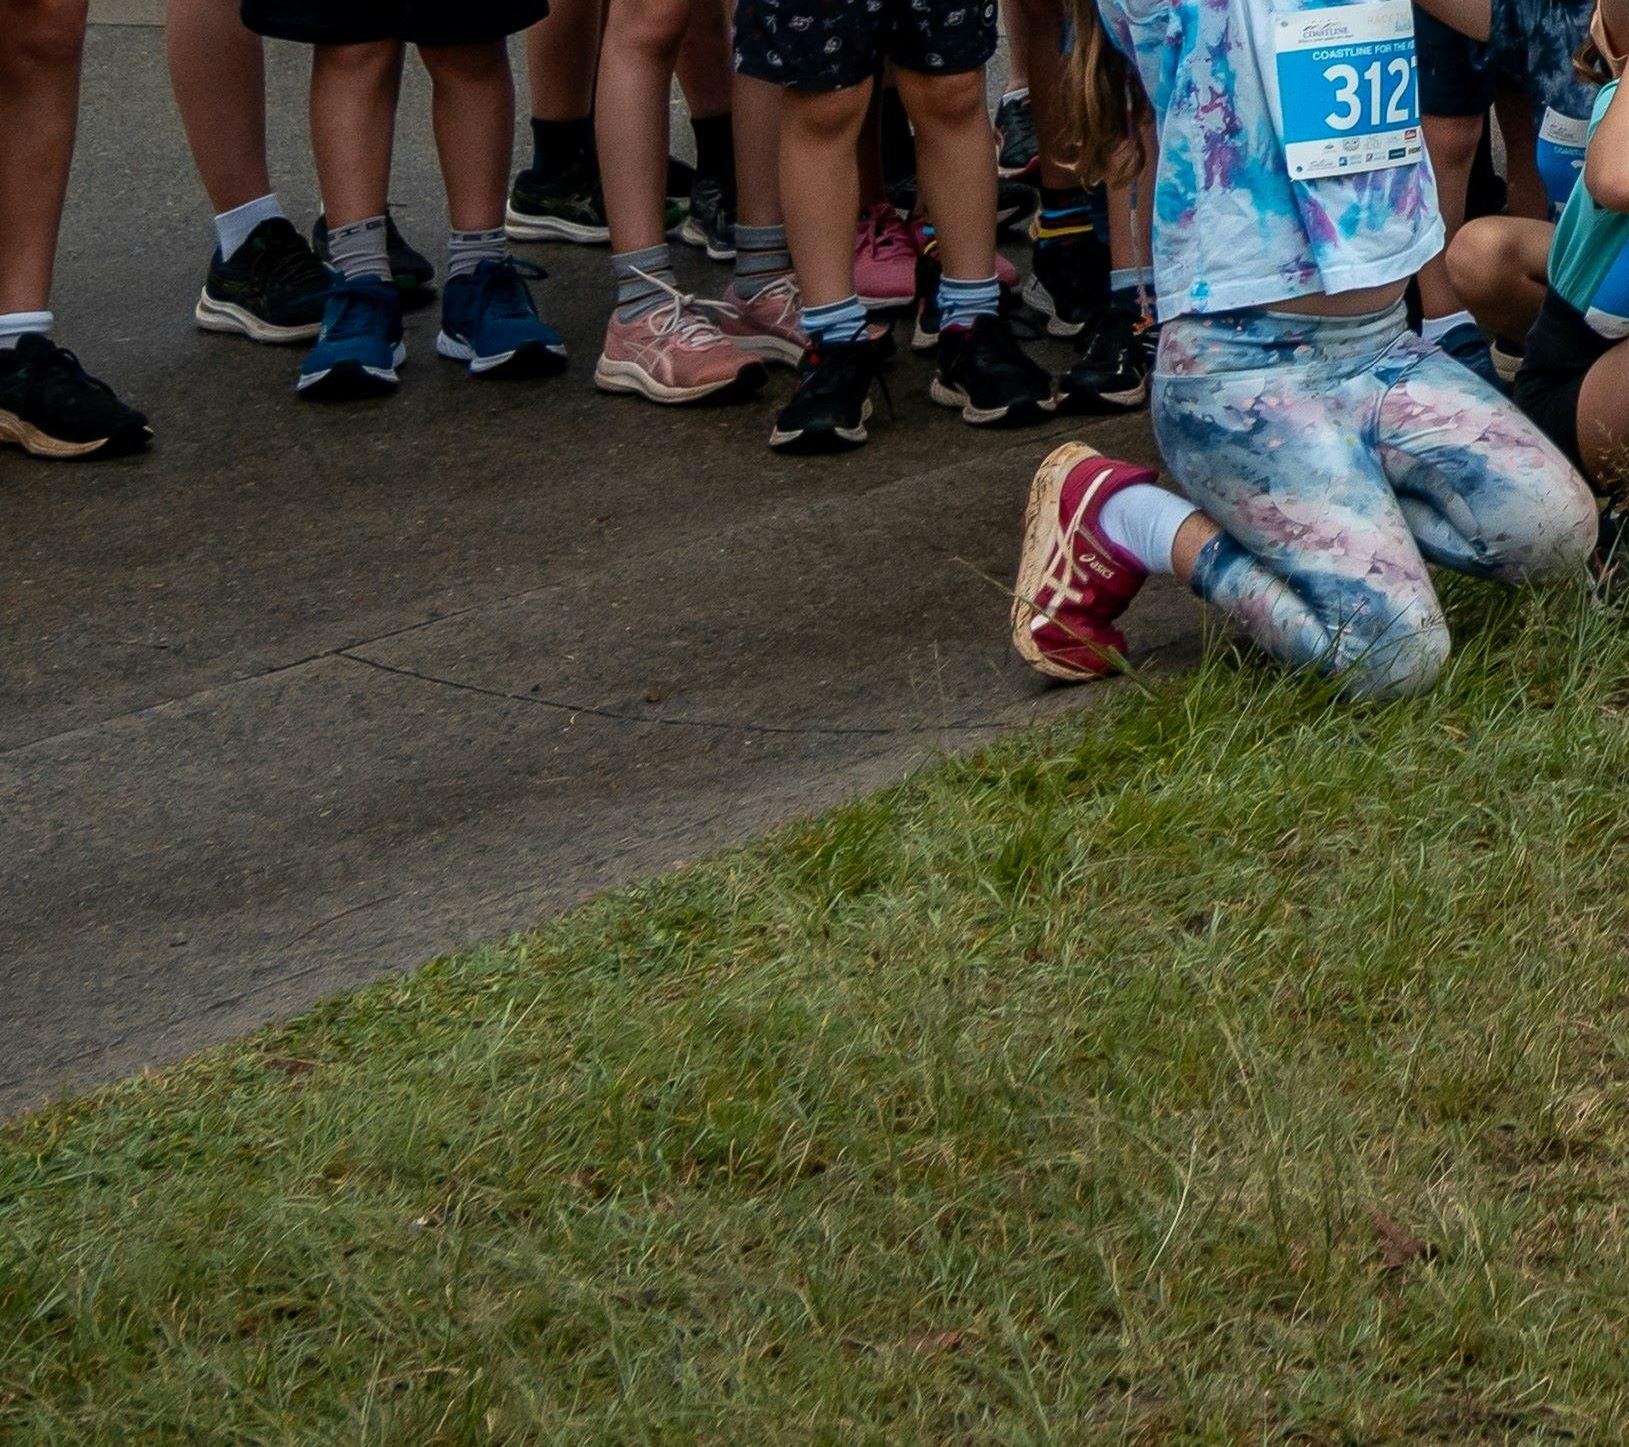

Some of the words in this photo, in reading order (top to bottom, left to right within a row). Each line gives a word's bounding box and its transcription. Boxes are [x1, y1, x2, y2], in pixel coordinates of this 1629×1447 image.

[1312, 47, 1372, 60] COASTLINE
[1374, 45, 1393, 56] FOR
[1394, 43, 1407, 53] THE
